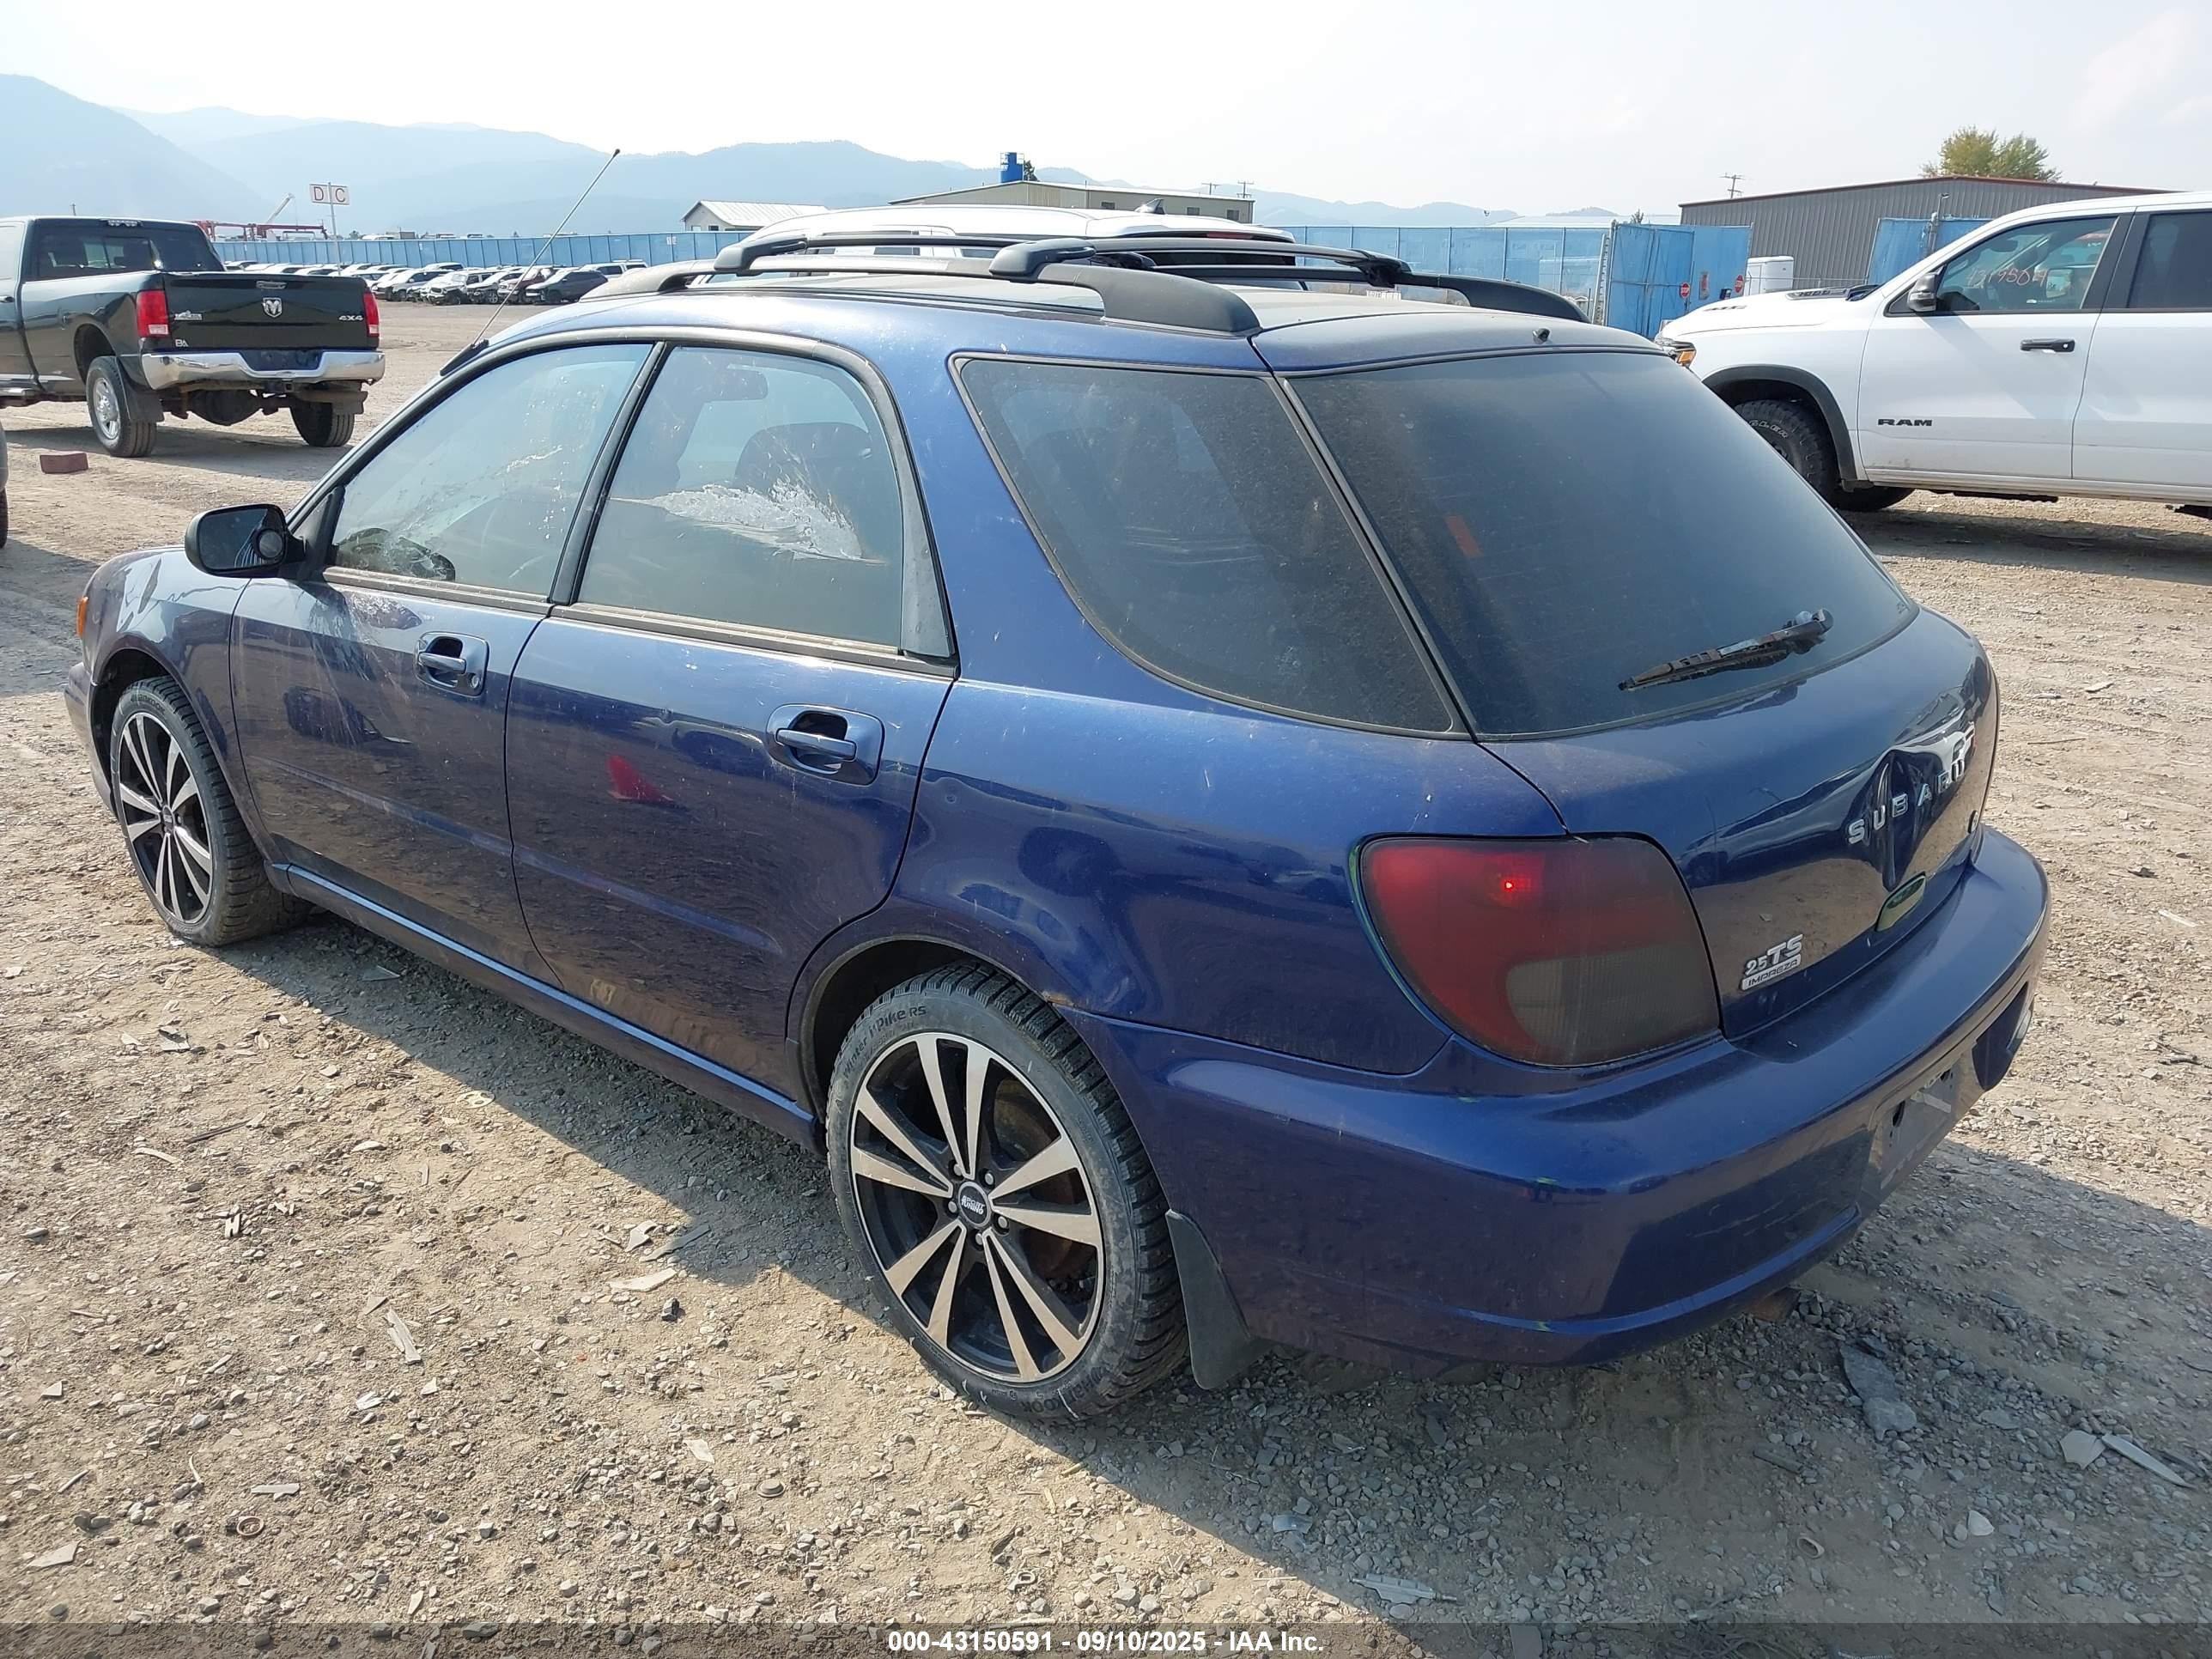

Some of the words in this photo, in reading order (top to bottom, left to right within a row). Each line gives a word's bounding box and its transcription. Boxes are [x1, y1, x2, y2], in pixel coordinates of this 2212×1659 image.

[313, 186, 324, 201] D
[336, 188, 345, 203] C
[1877, 418, 1933, 427] RAM
[1848, 758, 1966, 844] SUBARU
[1747, 958, 1799, 987] IMPREZA
[908, 1006, 927, 1018] RS
